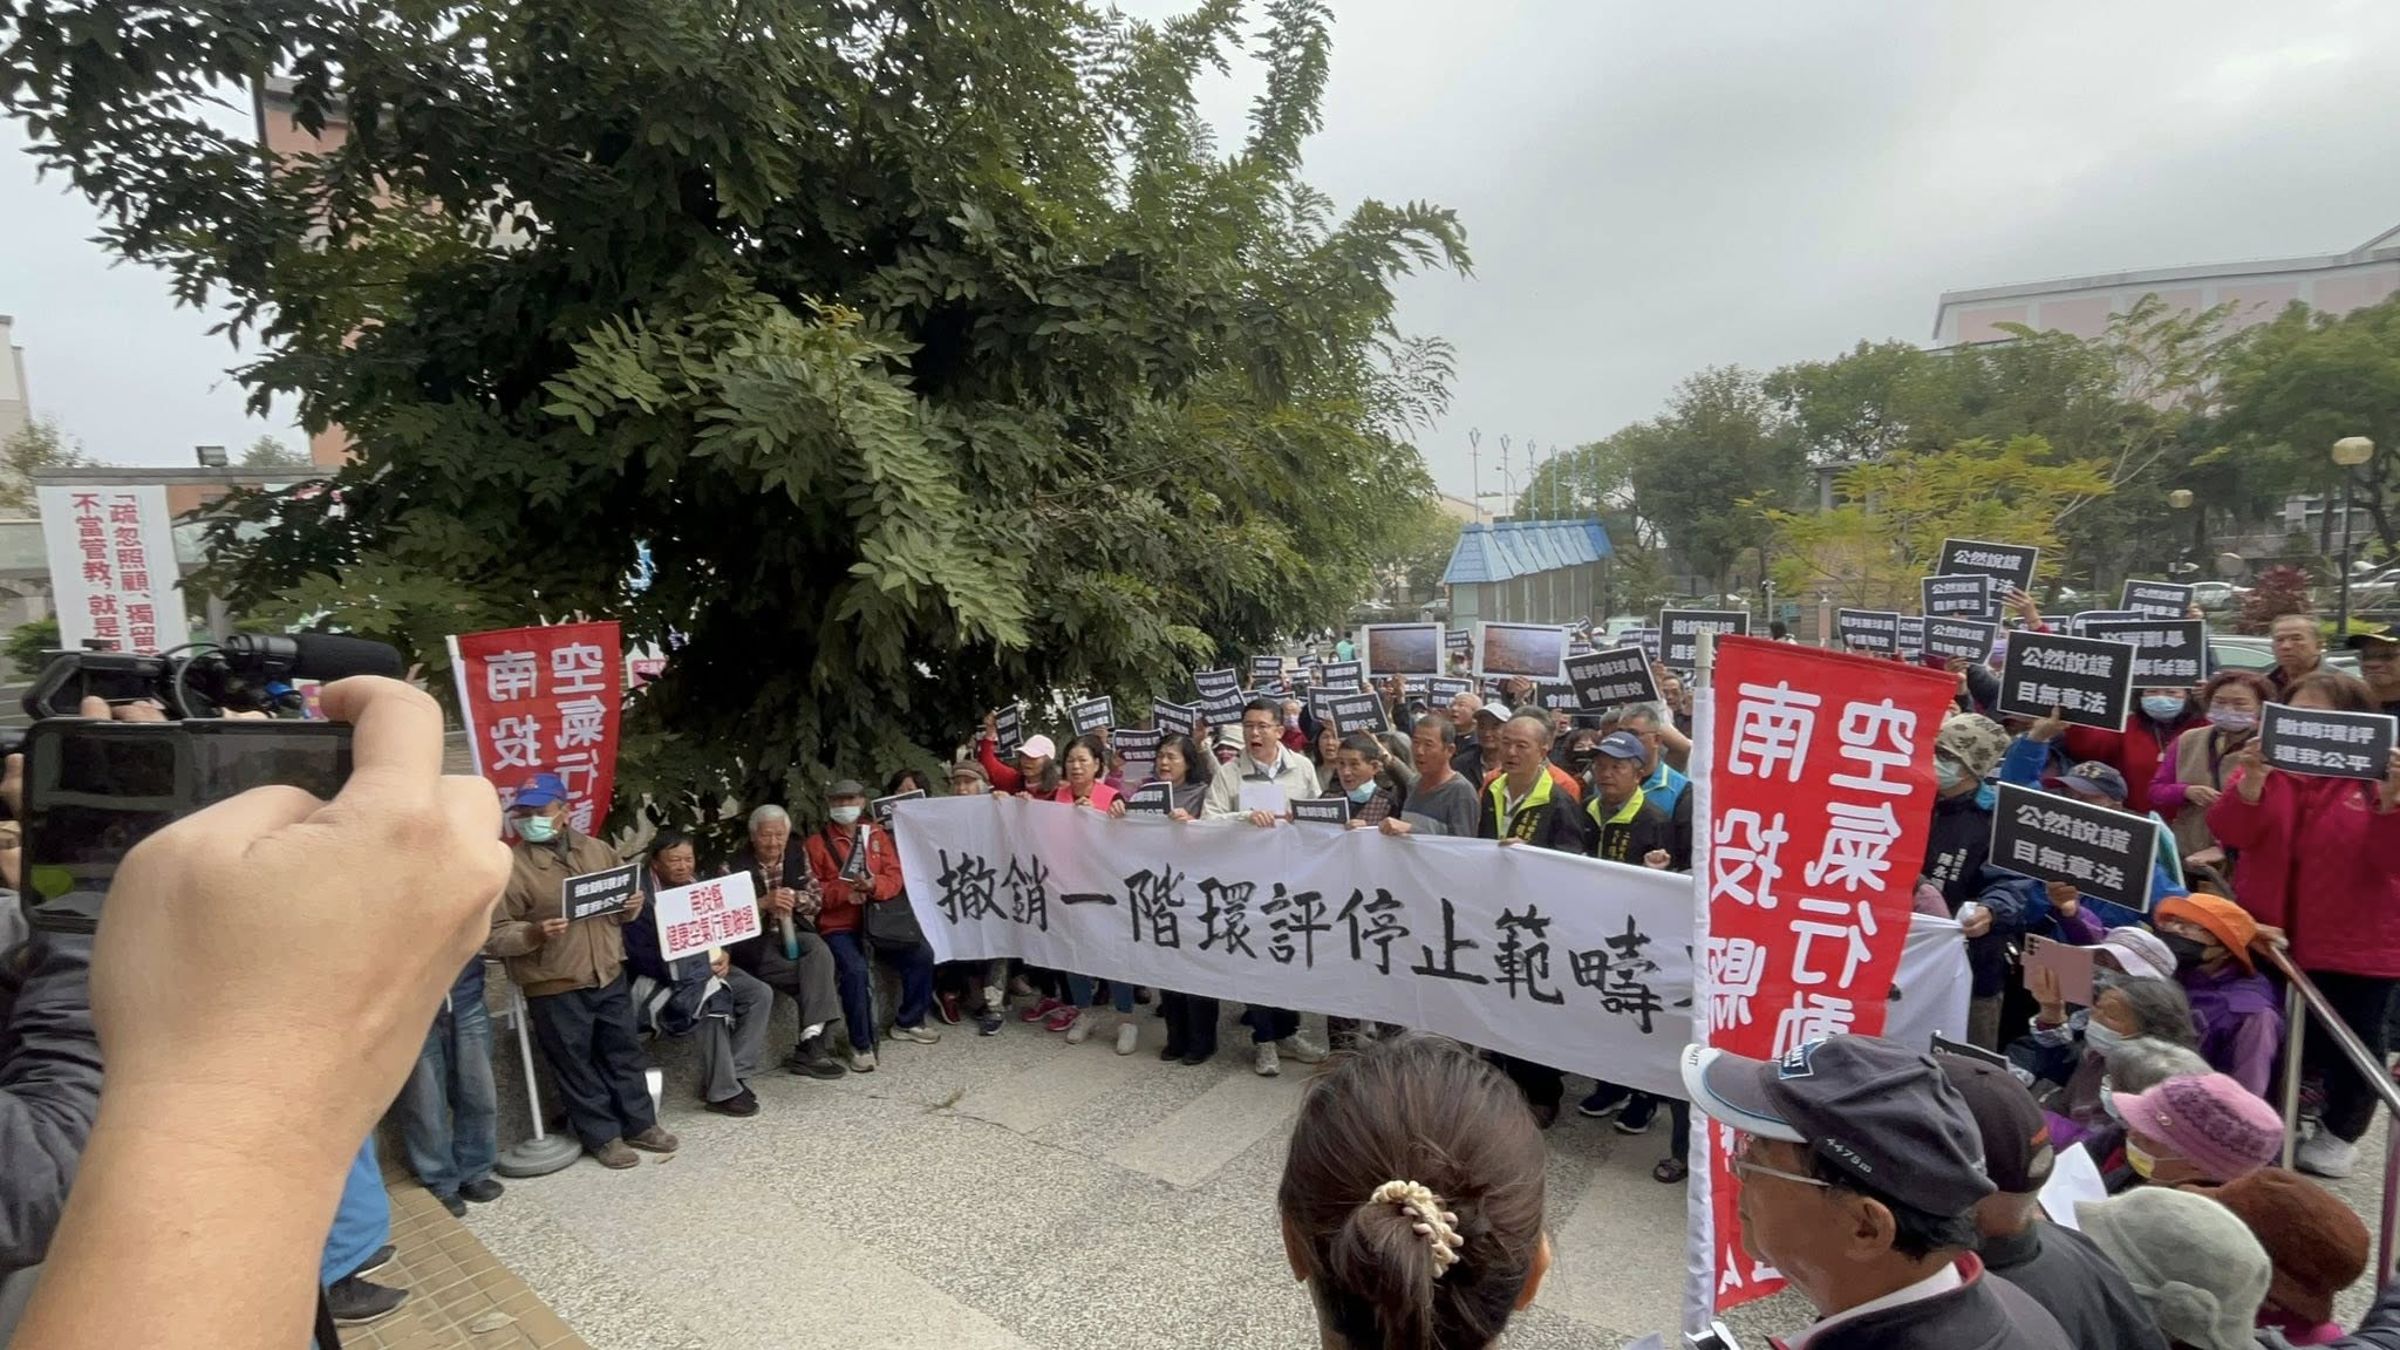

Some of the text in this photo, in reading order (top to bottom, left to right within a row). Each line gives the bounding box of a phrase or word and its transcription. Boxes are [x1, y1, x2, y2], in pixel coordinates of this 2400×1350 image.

[1953, 550, 2022, 571] 公然說謊
[2020, 645, 2114, 679] 公然說謊
[2016, 680, 2107, 717] 目無章法
[2275, 716, 2375, 745] 撤銷環評
[2273, 744, 2372, 772] 還我公平
[2015, 803, 2133, 855] 公然說謊
[2012, 840, 2125, 892] 目無章法
